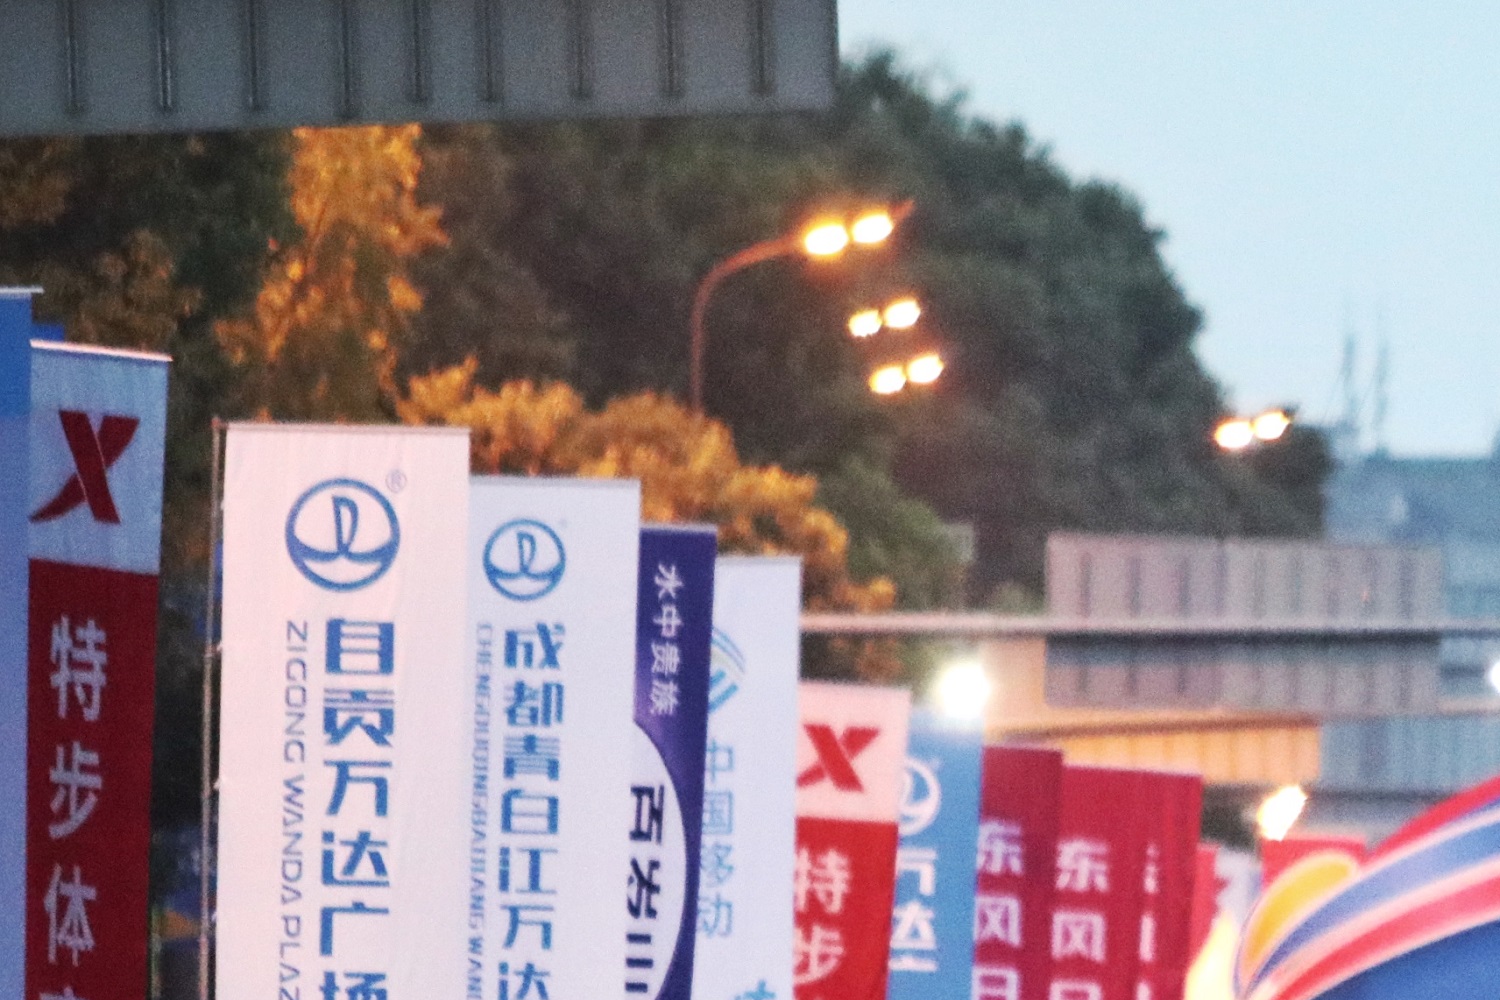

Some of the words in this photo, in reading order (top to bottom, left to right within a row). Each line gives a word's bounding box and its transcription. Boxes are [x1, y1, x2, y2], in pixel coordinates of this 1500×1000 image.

[284, 619, 308, 764] ZIGONG
[650, 562, 684, 716] 水中贵族
[280, 774, 305, 906] WANDA
